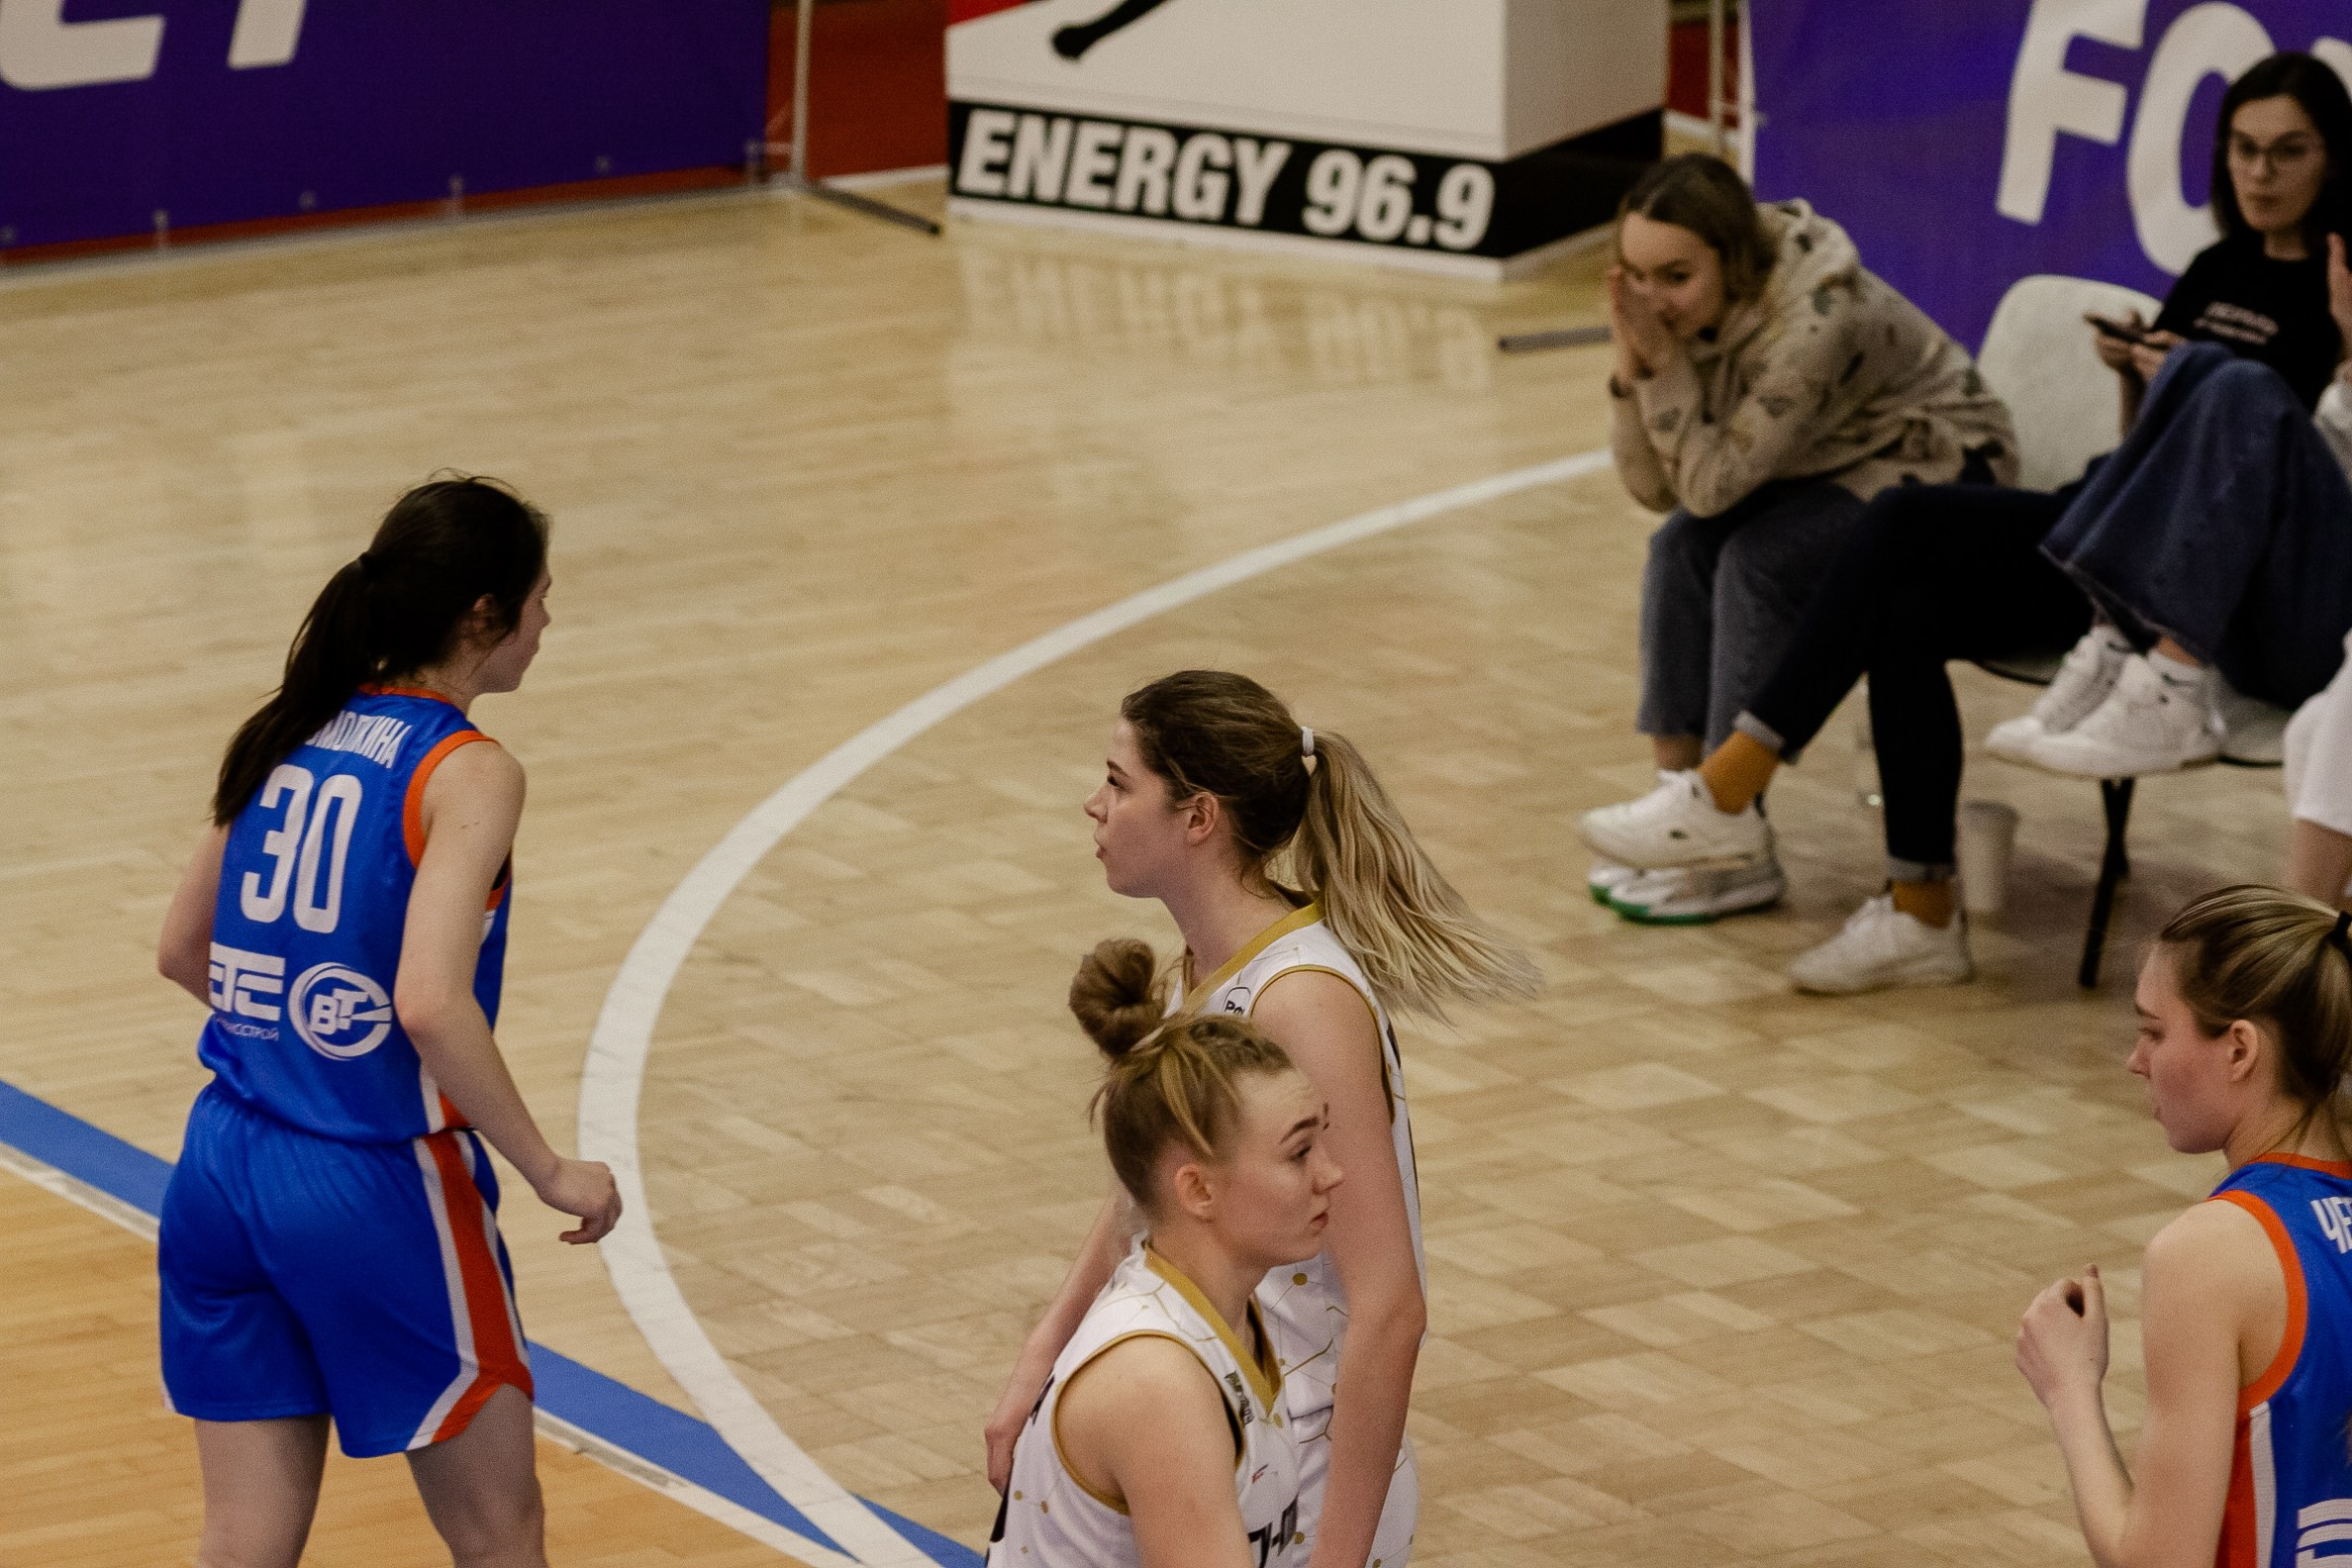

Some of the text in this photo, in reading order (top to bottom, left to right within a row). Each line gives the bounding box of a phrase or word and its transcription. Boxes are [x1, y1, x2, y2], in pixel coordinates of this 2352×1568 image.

[956, 108, 1497, 251] ENERGY 96.9
[241, 763, 363, 934] 30
